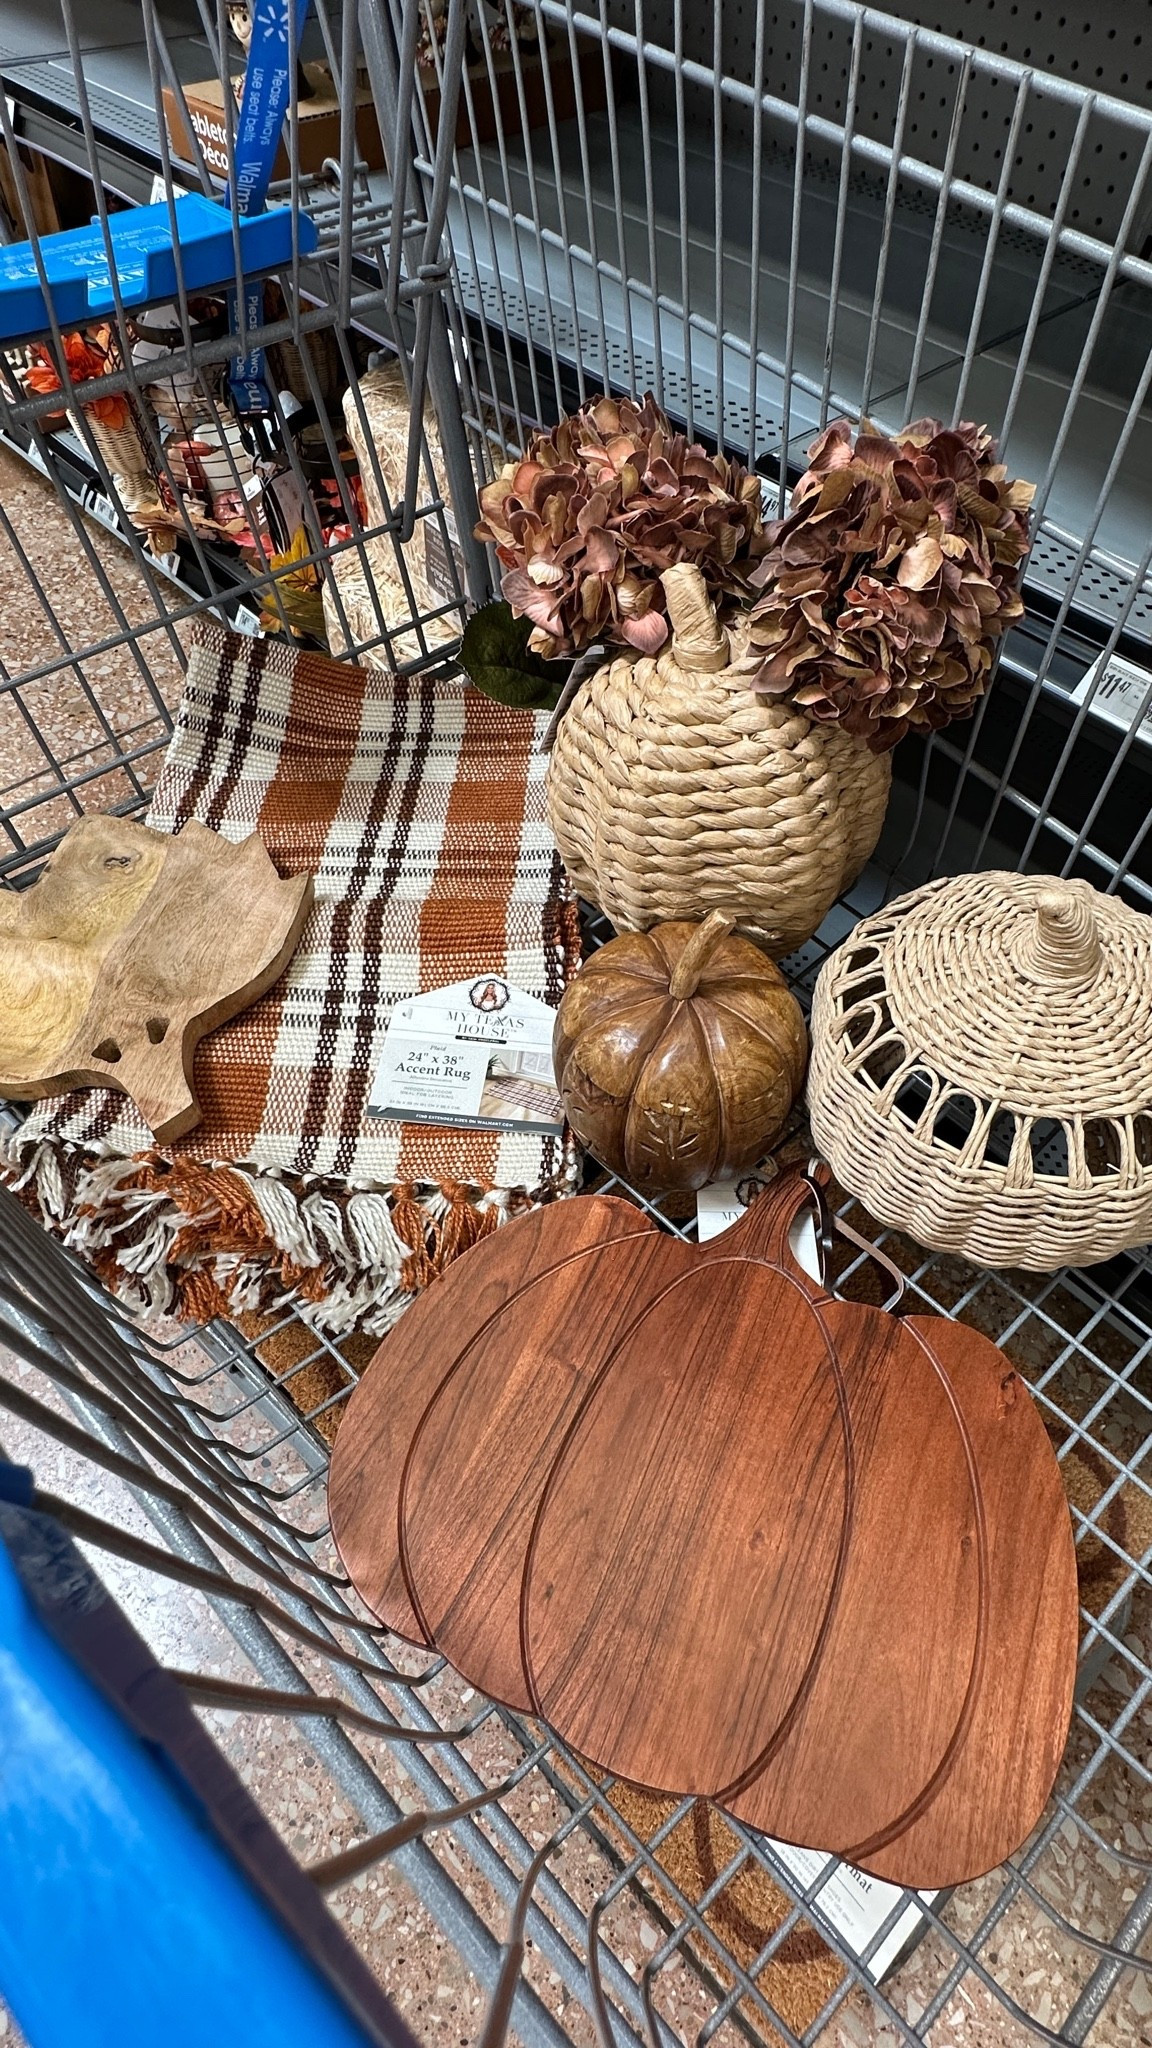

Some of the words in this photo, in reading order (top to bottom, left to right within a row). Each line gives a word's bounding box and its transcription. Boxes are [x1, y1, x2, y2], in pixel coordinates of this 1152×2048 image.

[251, 67, 264, 89] use
[248, 92, 261, 116] seat
[260, 110, 279, 146] Always
[198, 137, 229, 171] Déco
[237, 162, 262, 214] Walma
[248, 295, 259, 330] Pleas
[448, 1011, 470, 1022] MY
[475, 1014, 525, 1029] TEXAS
[407, 1052, 429, 1062] 24"
[431, 1056, 440, 1064] x
[442, 1055, 464, 1066] 38"
[394, 1062, 441, 1076] Accent
[444, 1066, 471, 1081] Rug
[722, 1211, 740, 1221] MY
